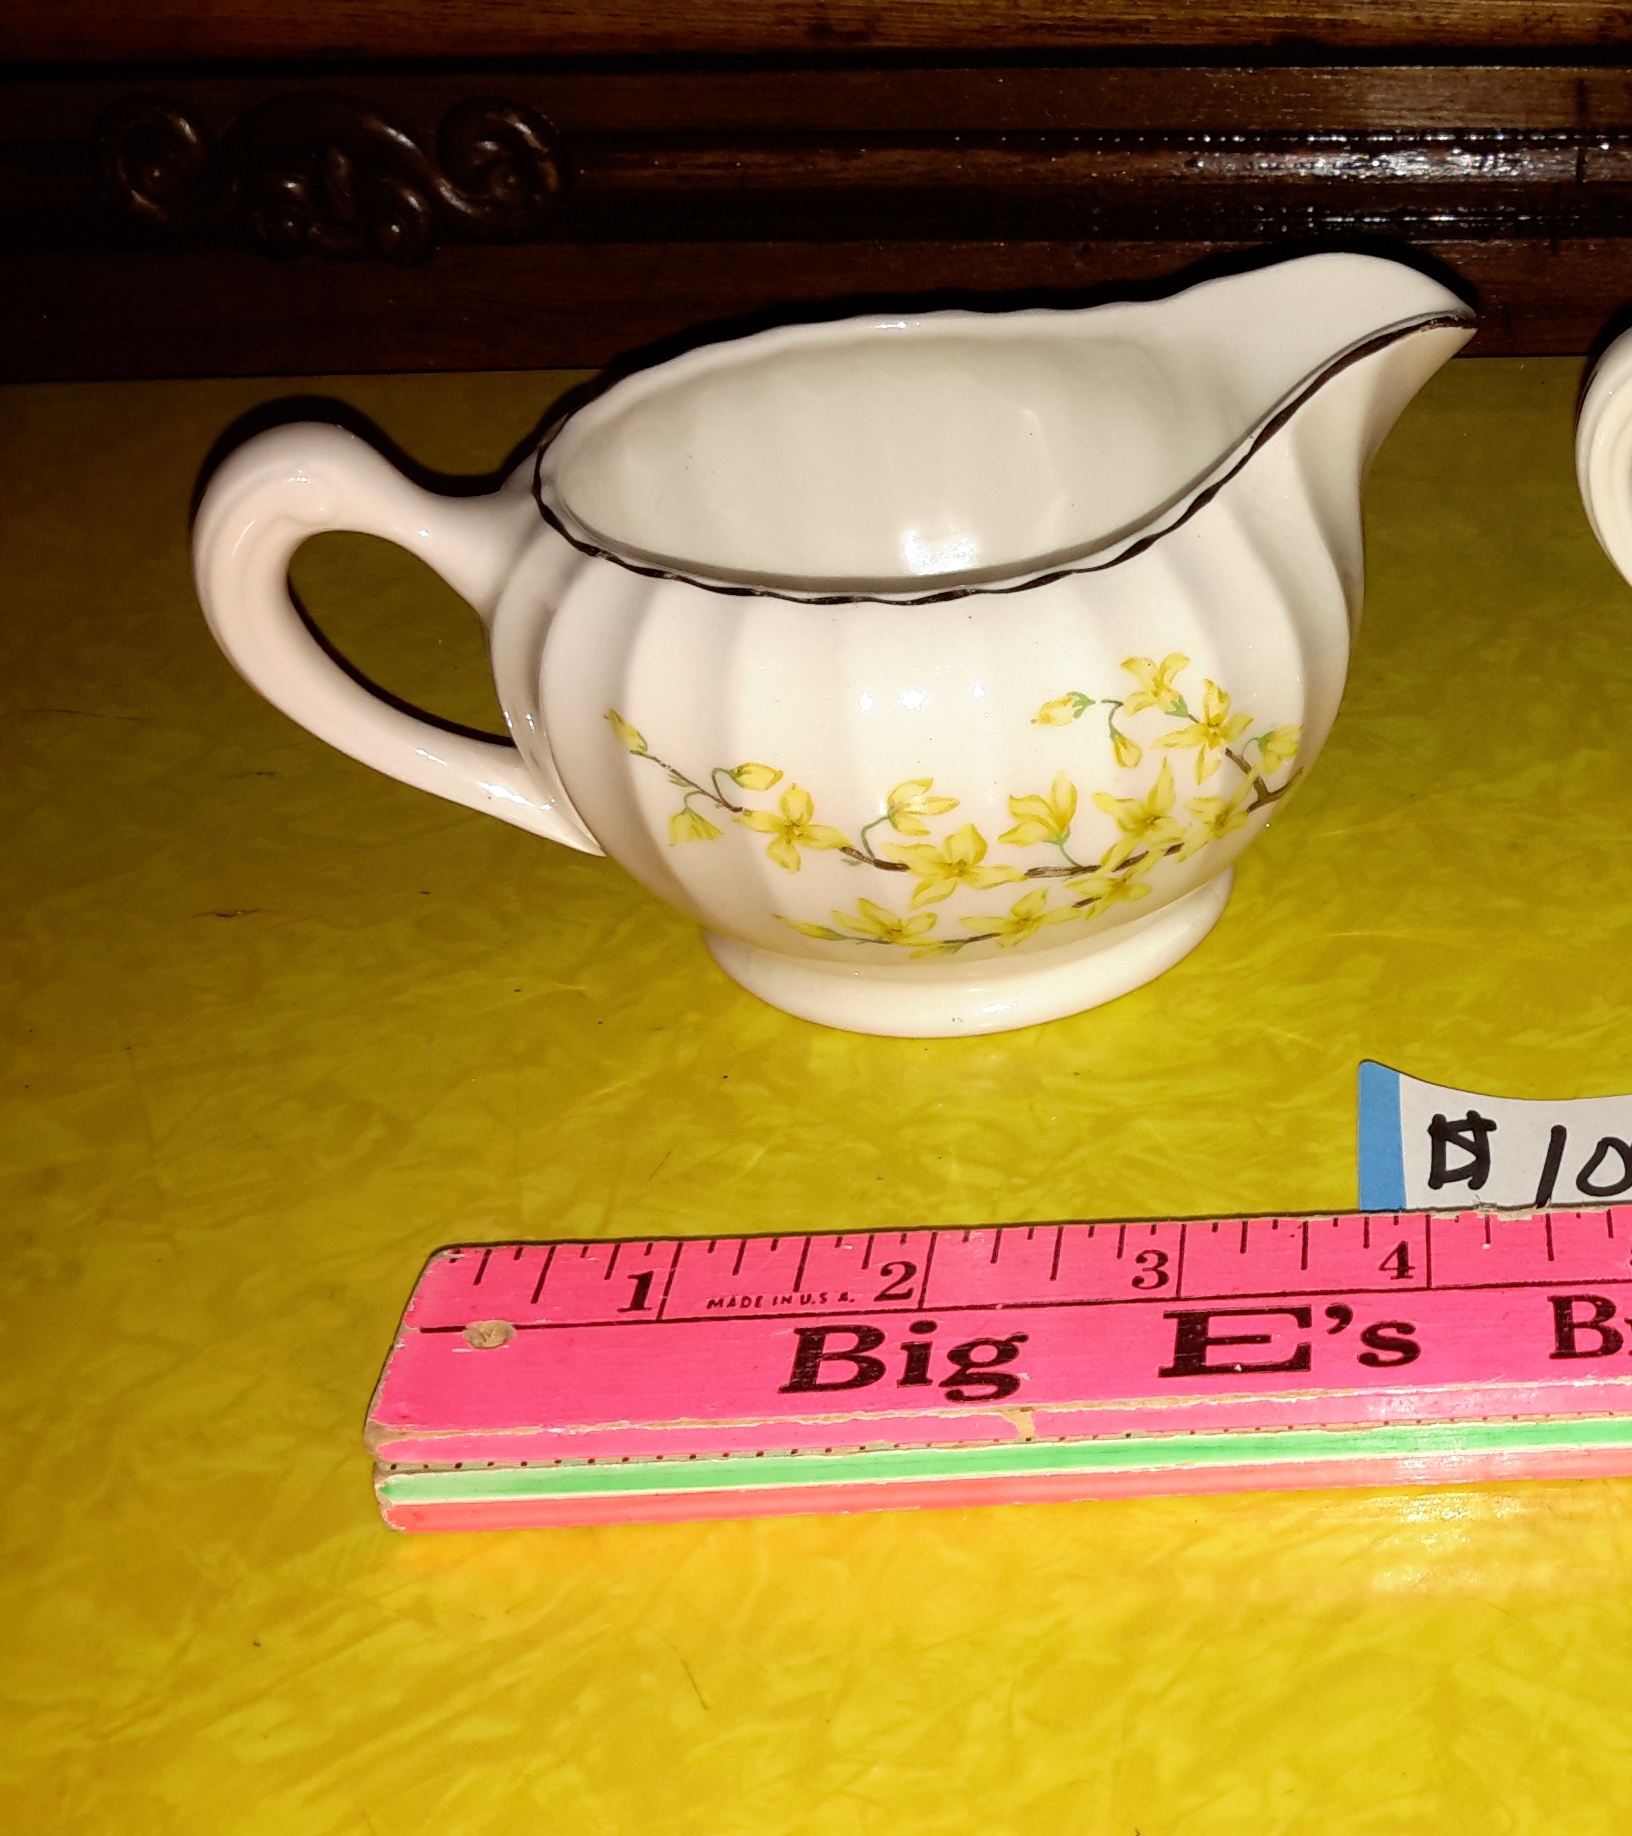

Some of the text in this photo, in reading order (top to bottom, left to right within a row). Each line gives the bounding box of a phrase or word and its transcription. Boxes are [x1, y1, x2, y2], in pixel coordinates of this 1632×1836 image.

[616, 1270, 656, 1313] 1
[879, 1260, 918, 1303] 2
[1131, 1248, 1171, 1291] 3
[1379, 1240, 1414, 1280] 4
[706, 1296, 765, 1310] MADE
[771, 1294, 793, 1307] IN
[777, 1319, 1030, 1404] Big
[1157, 1302, 1422, 1379] E's
